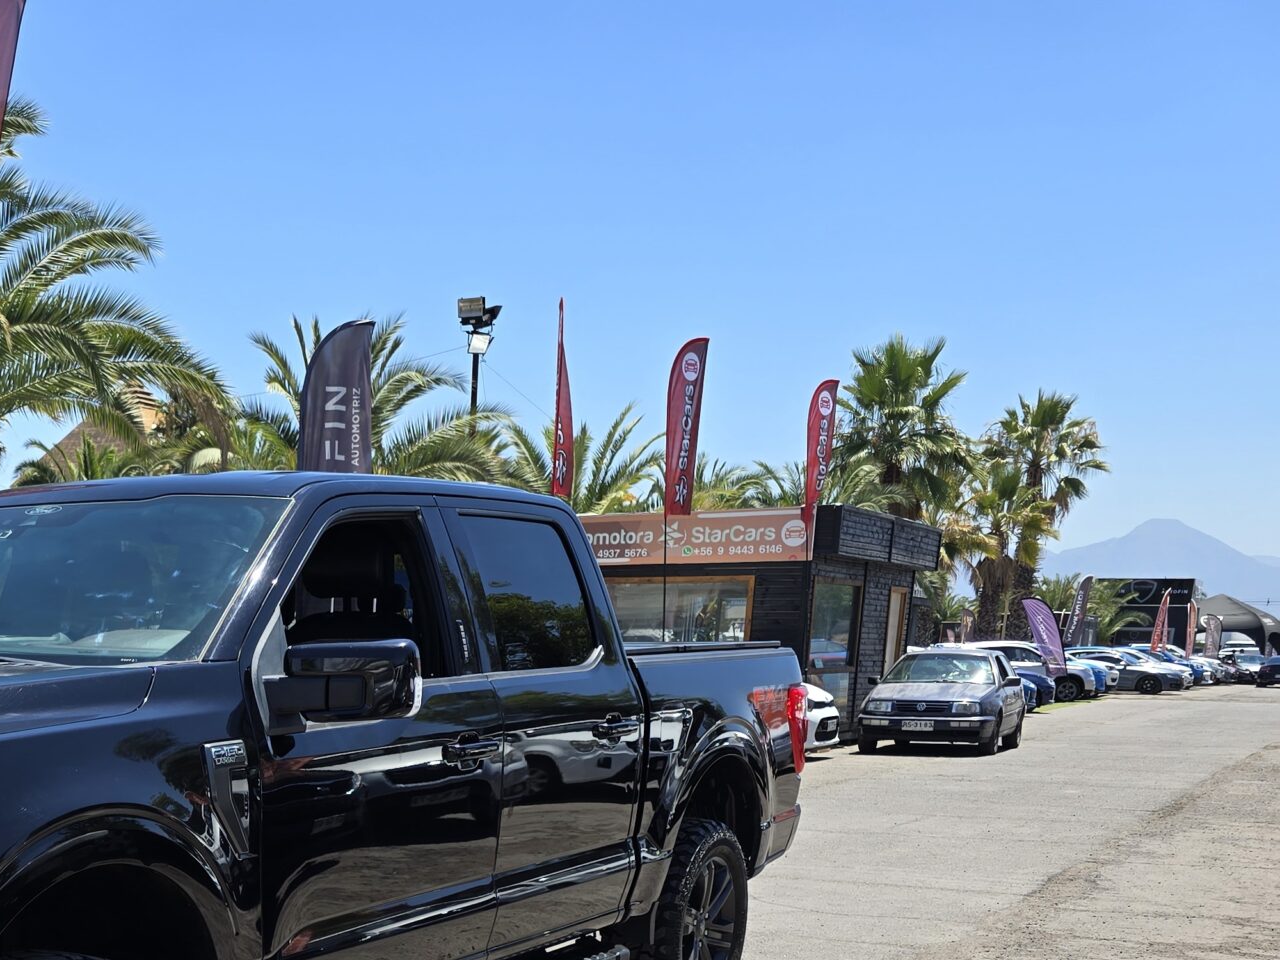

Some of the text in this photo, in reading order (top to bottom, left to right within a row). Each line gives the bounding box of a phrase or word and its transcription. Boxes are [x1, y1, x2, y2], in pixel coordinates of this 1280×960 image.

[351, 387, 361, 466] AUTOMOTRIZ
[678, 384, 694, 470] StarCars
[691, 525, 776, 544] StarCars
[597, 549, 648, 558] 4937 5676
[694, 544, 782, 556] +56 9 9443 6146
